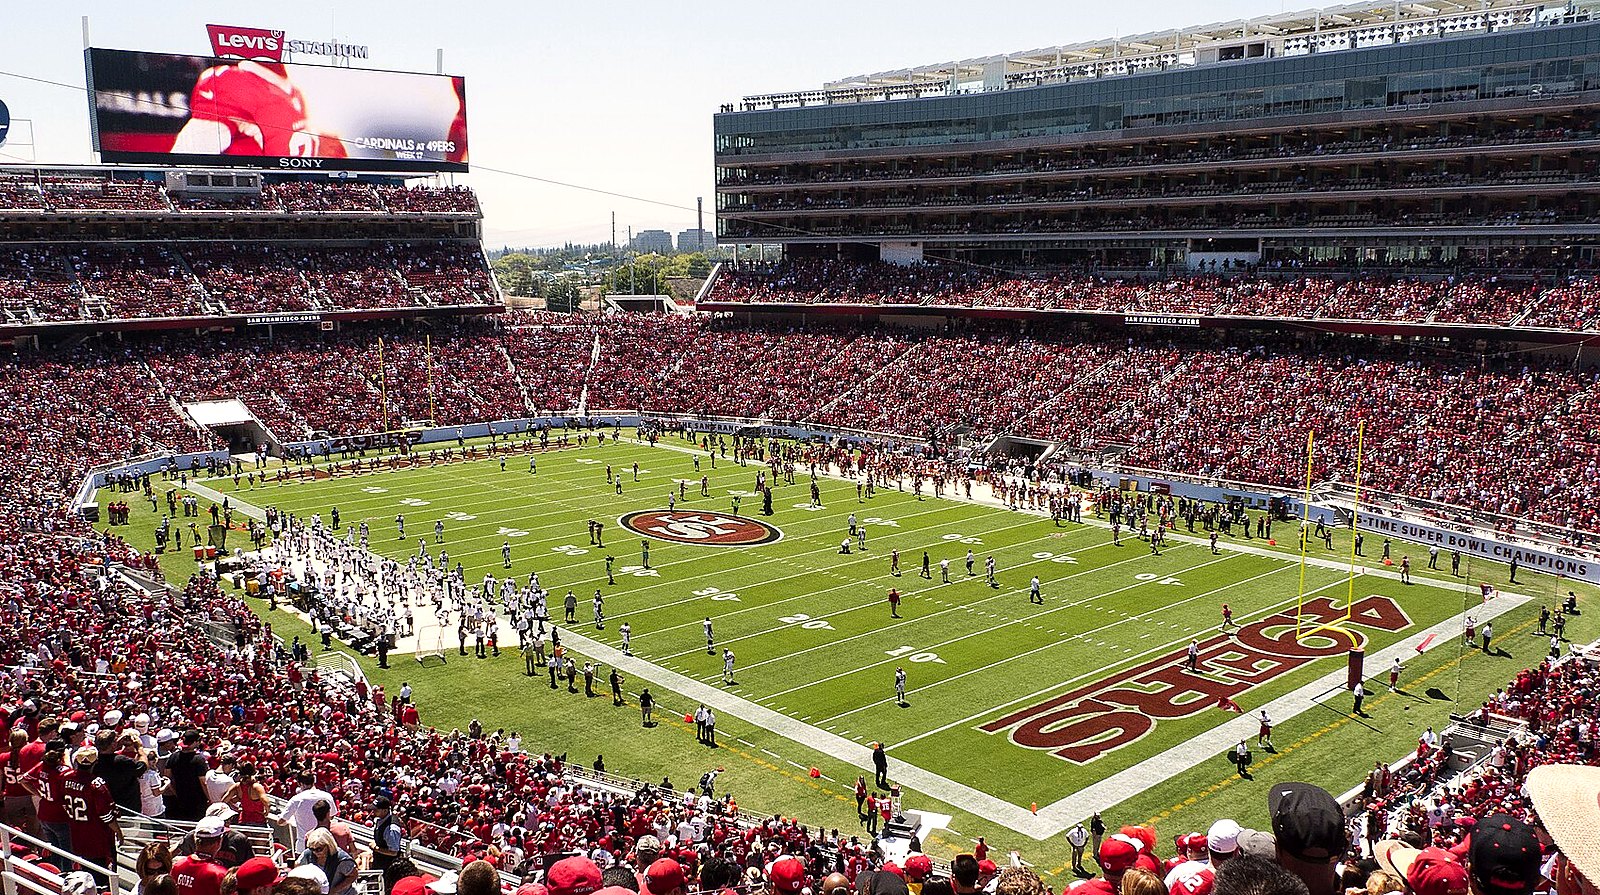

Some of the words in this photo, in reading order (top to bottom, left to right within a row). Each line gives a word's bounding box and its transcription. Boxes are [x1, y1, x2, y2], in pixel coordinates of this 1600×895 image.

[289, 39, 369, 59] STADIUM
[355, 137, 415, 151] CARDINALS
[416, 142, 425, 151] AT
[426, 140, 456, 153] 49ERS
[279, 158, 324, 168] SONY
[395, 151, 416, 159] WEEK
[1356, 516, 1398, 533] 5-TIME
[1401, 525, 1444, 543] SUPER
[1448, 535, 1488, 554] BOWL
[1493, 546, 1588, 576] CHAMPIONS
[778, 614, 832, 630] 20
[885, 646, 942, 664] 10
[980, 595, 1414, 765] 49ERS
[62, 794, 89, 821] 32
[177, 873, 195, 888] GORE
